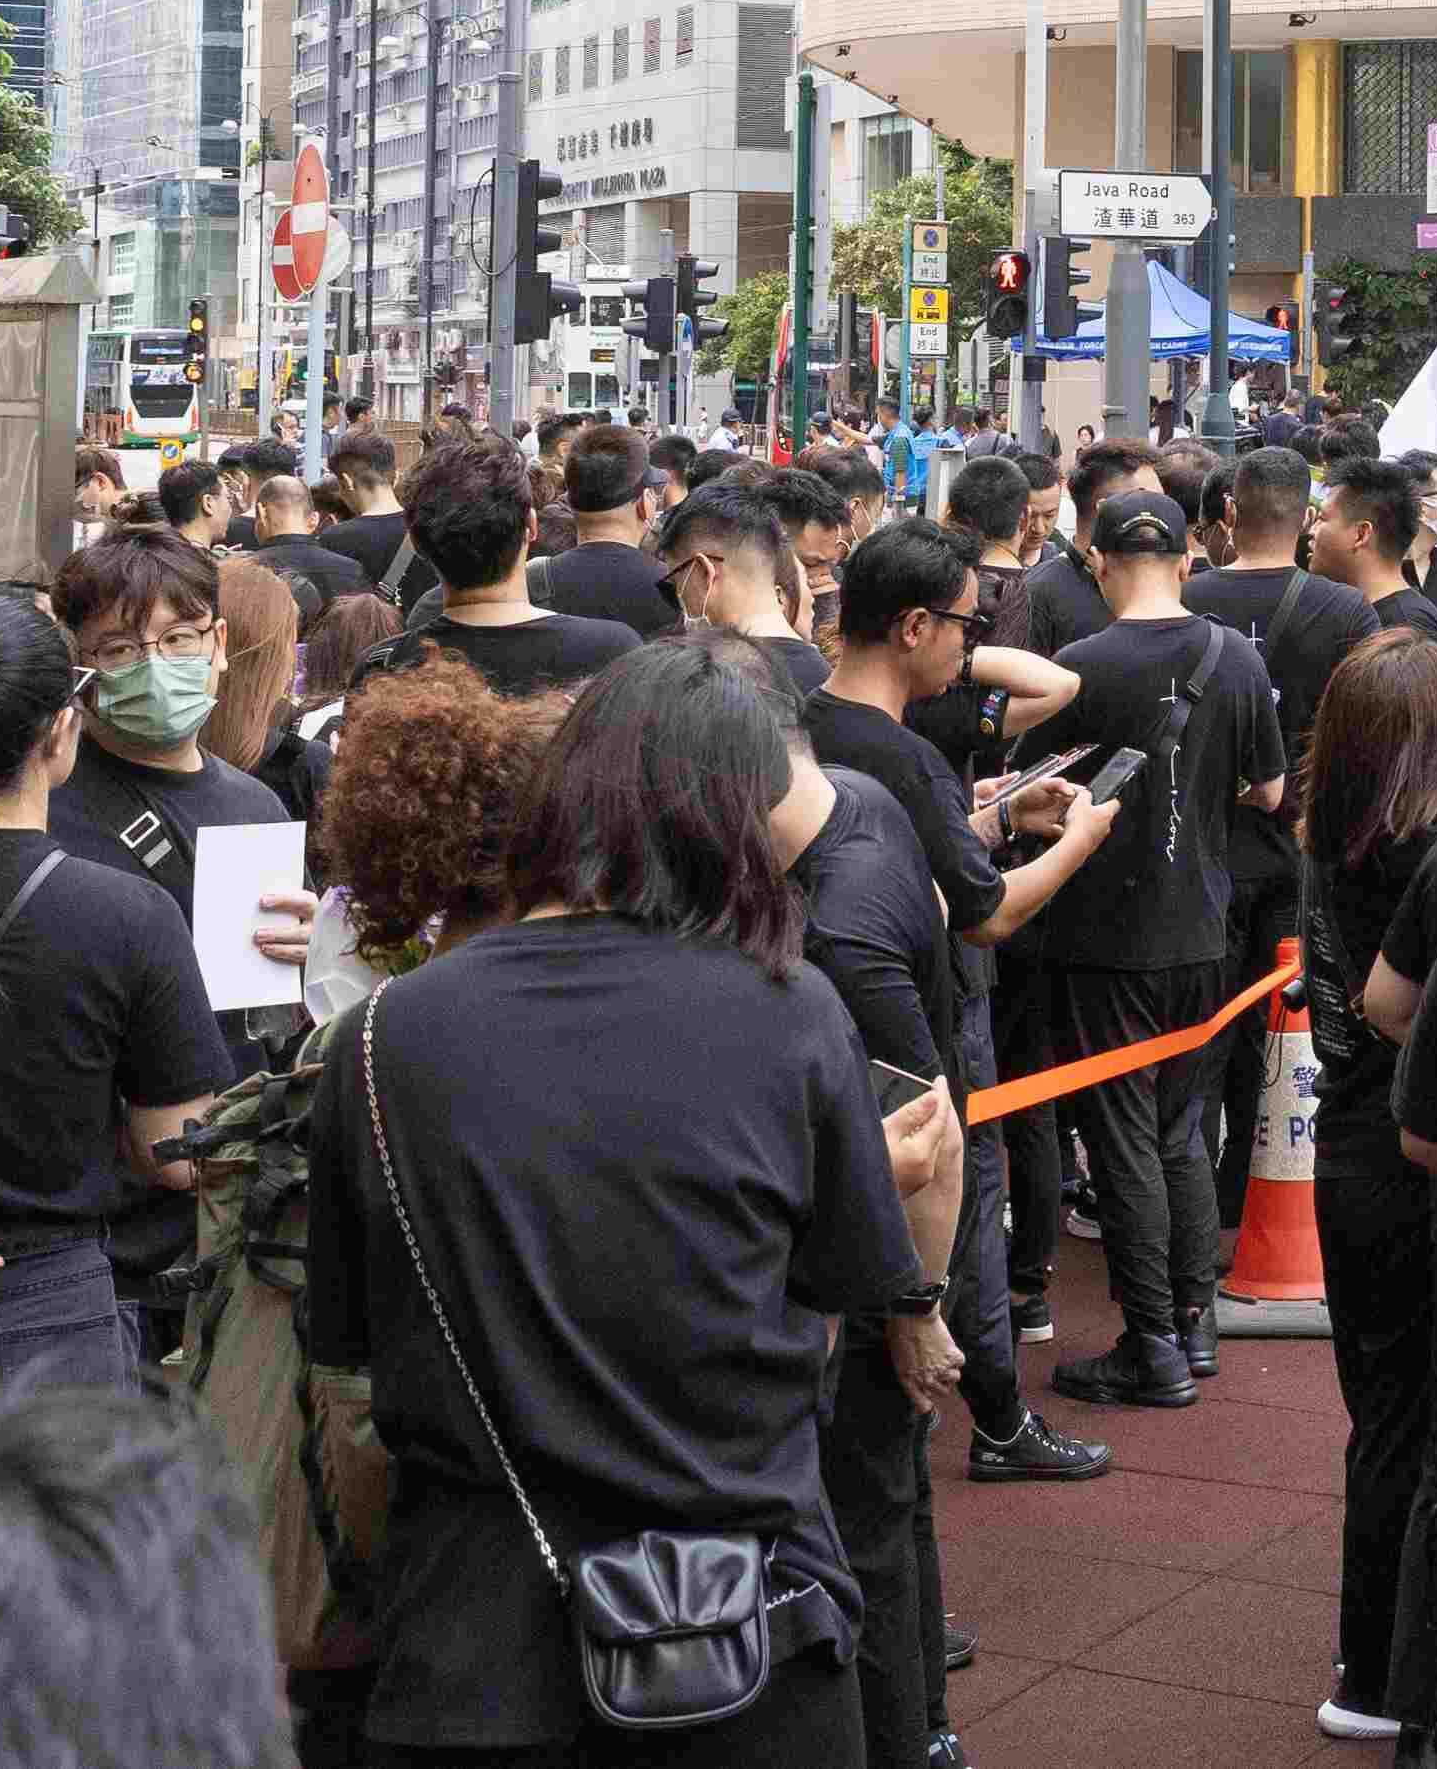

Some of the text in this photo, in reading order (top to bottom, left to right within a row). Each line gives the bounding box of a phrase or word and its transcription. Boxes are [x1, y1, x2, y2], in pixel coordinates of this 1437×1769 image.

[1083, 181, 1170, 199] Java Road
[1093, 206, 1196, 230] 渣華道 363
[923, 254, 939, 264] End
[920, 326, 938, 336] End
